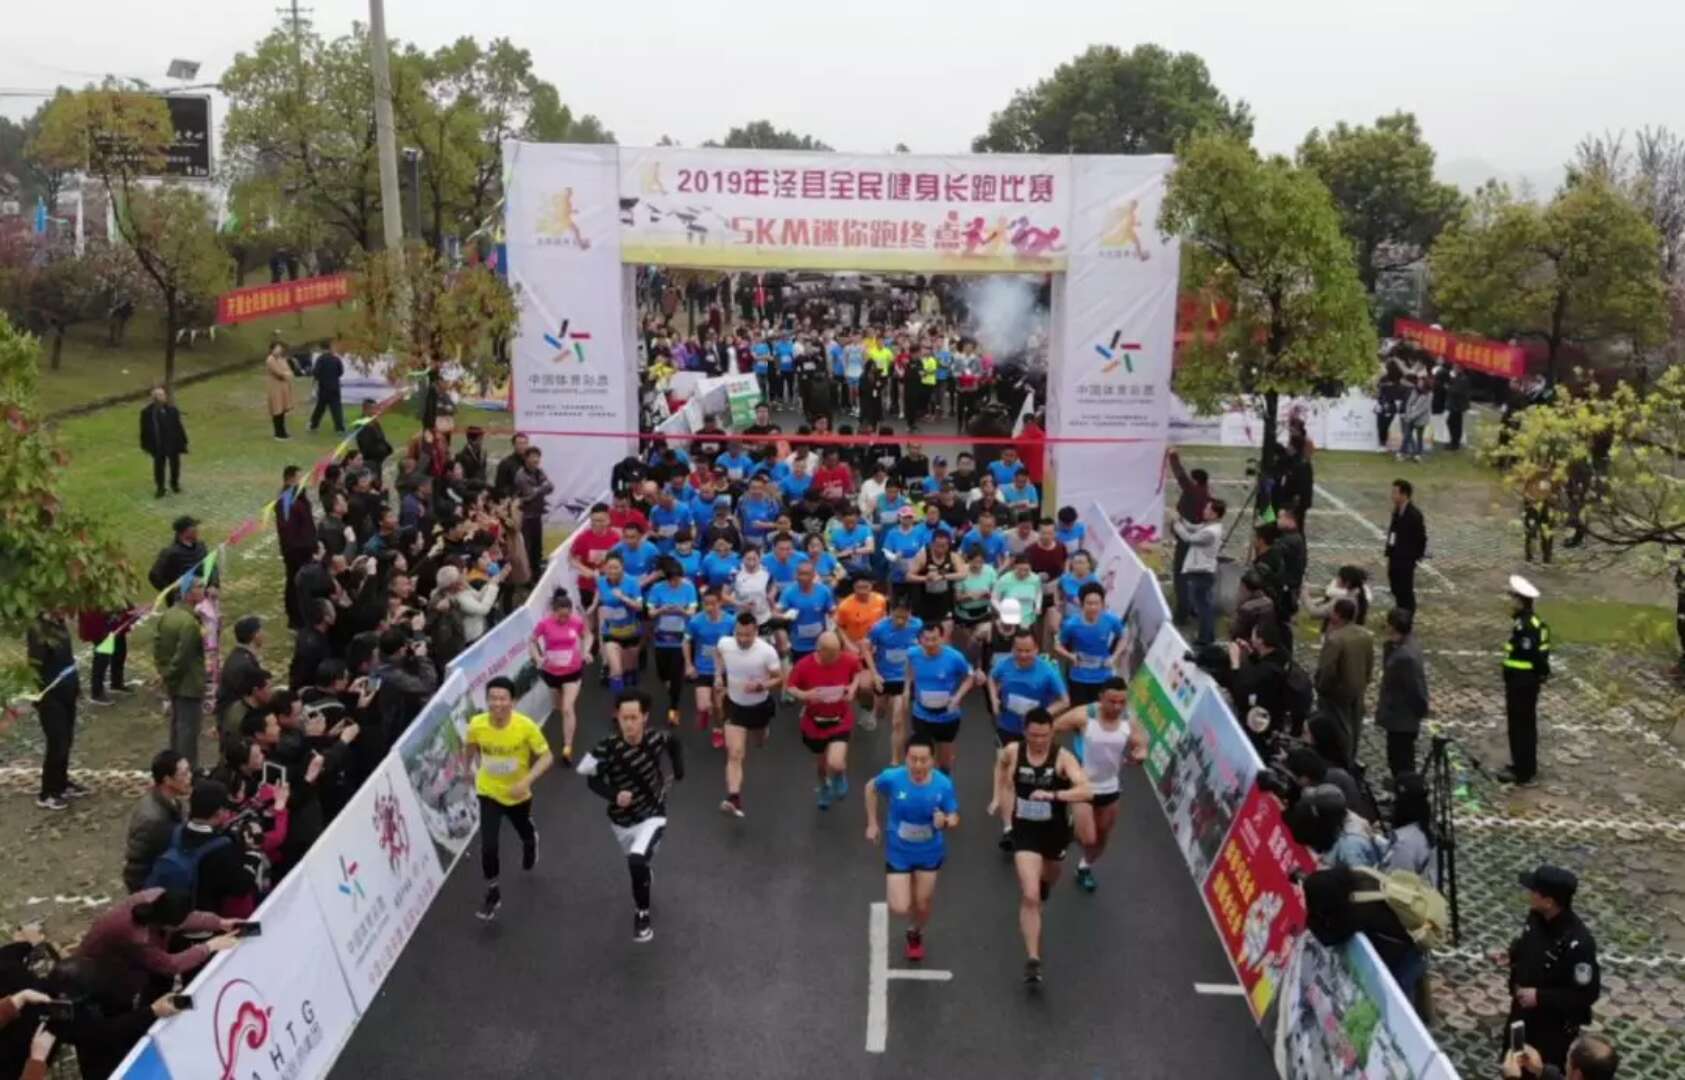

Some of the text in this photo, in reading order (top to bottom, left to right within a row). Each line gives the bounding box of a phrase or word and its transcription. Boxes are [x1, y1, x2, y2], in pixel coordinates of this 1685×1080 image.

[677, 169, 1054, 202] 2019年泾县全民健身长跑比赛
